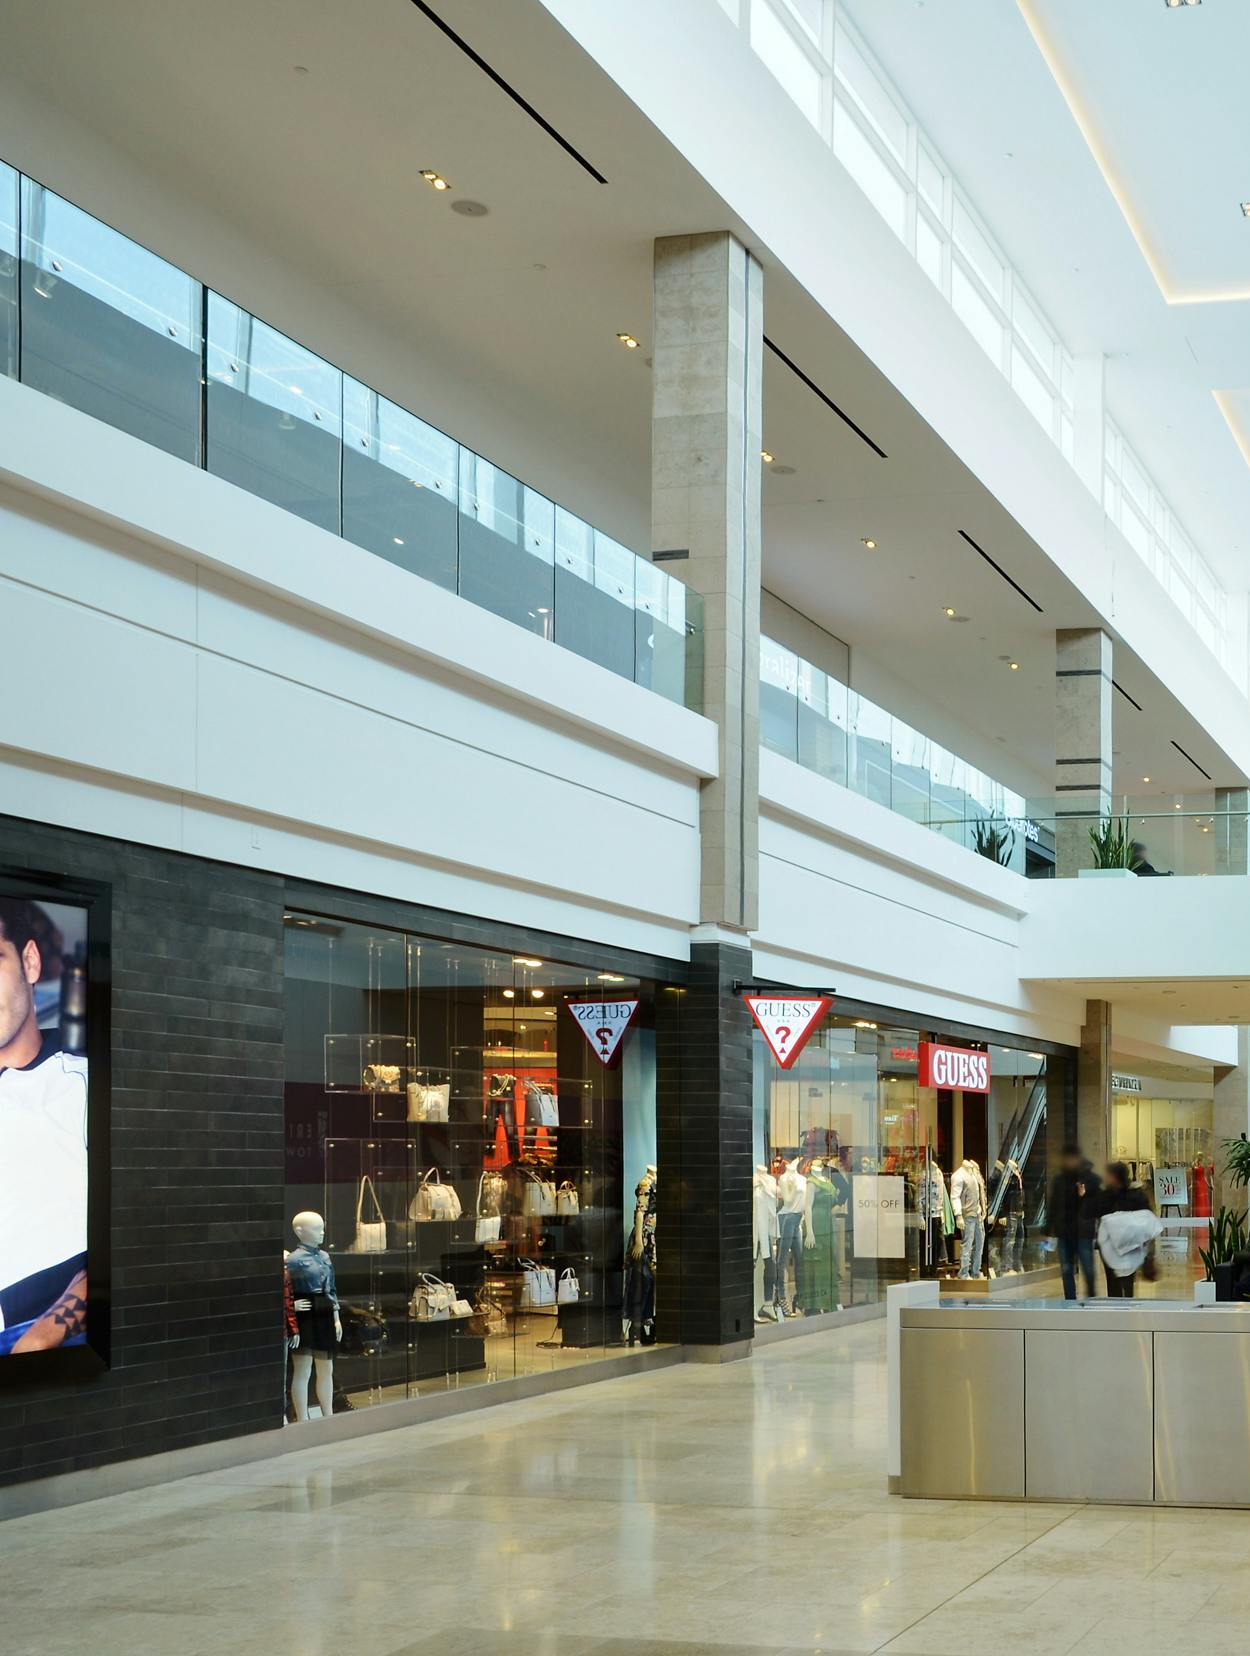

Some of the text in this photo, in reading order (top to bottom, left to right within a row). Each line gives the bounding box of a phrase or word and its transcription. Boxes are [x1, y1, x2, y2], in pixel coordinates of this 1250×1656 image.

[756, 1002, 811, 1018] GUESS
[933, 1049, 987, 1089] GUESS
[880, 1199, 900, 1209] OFF
